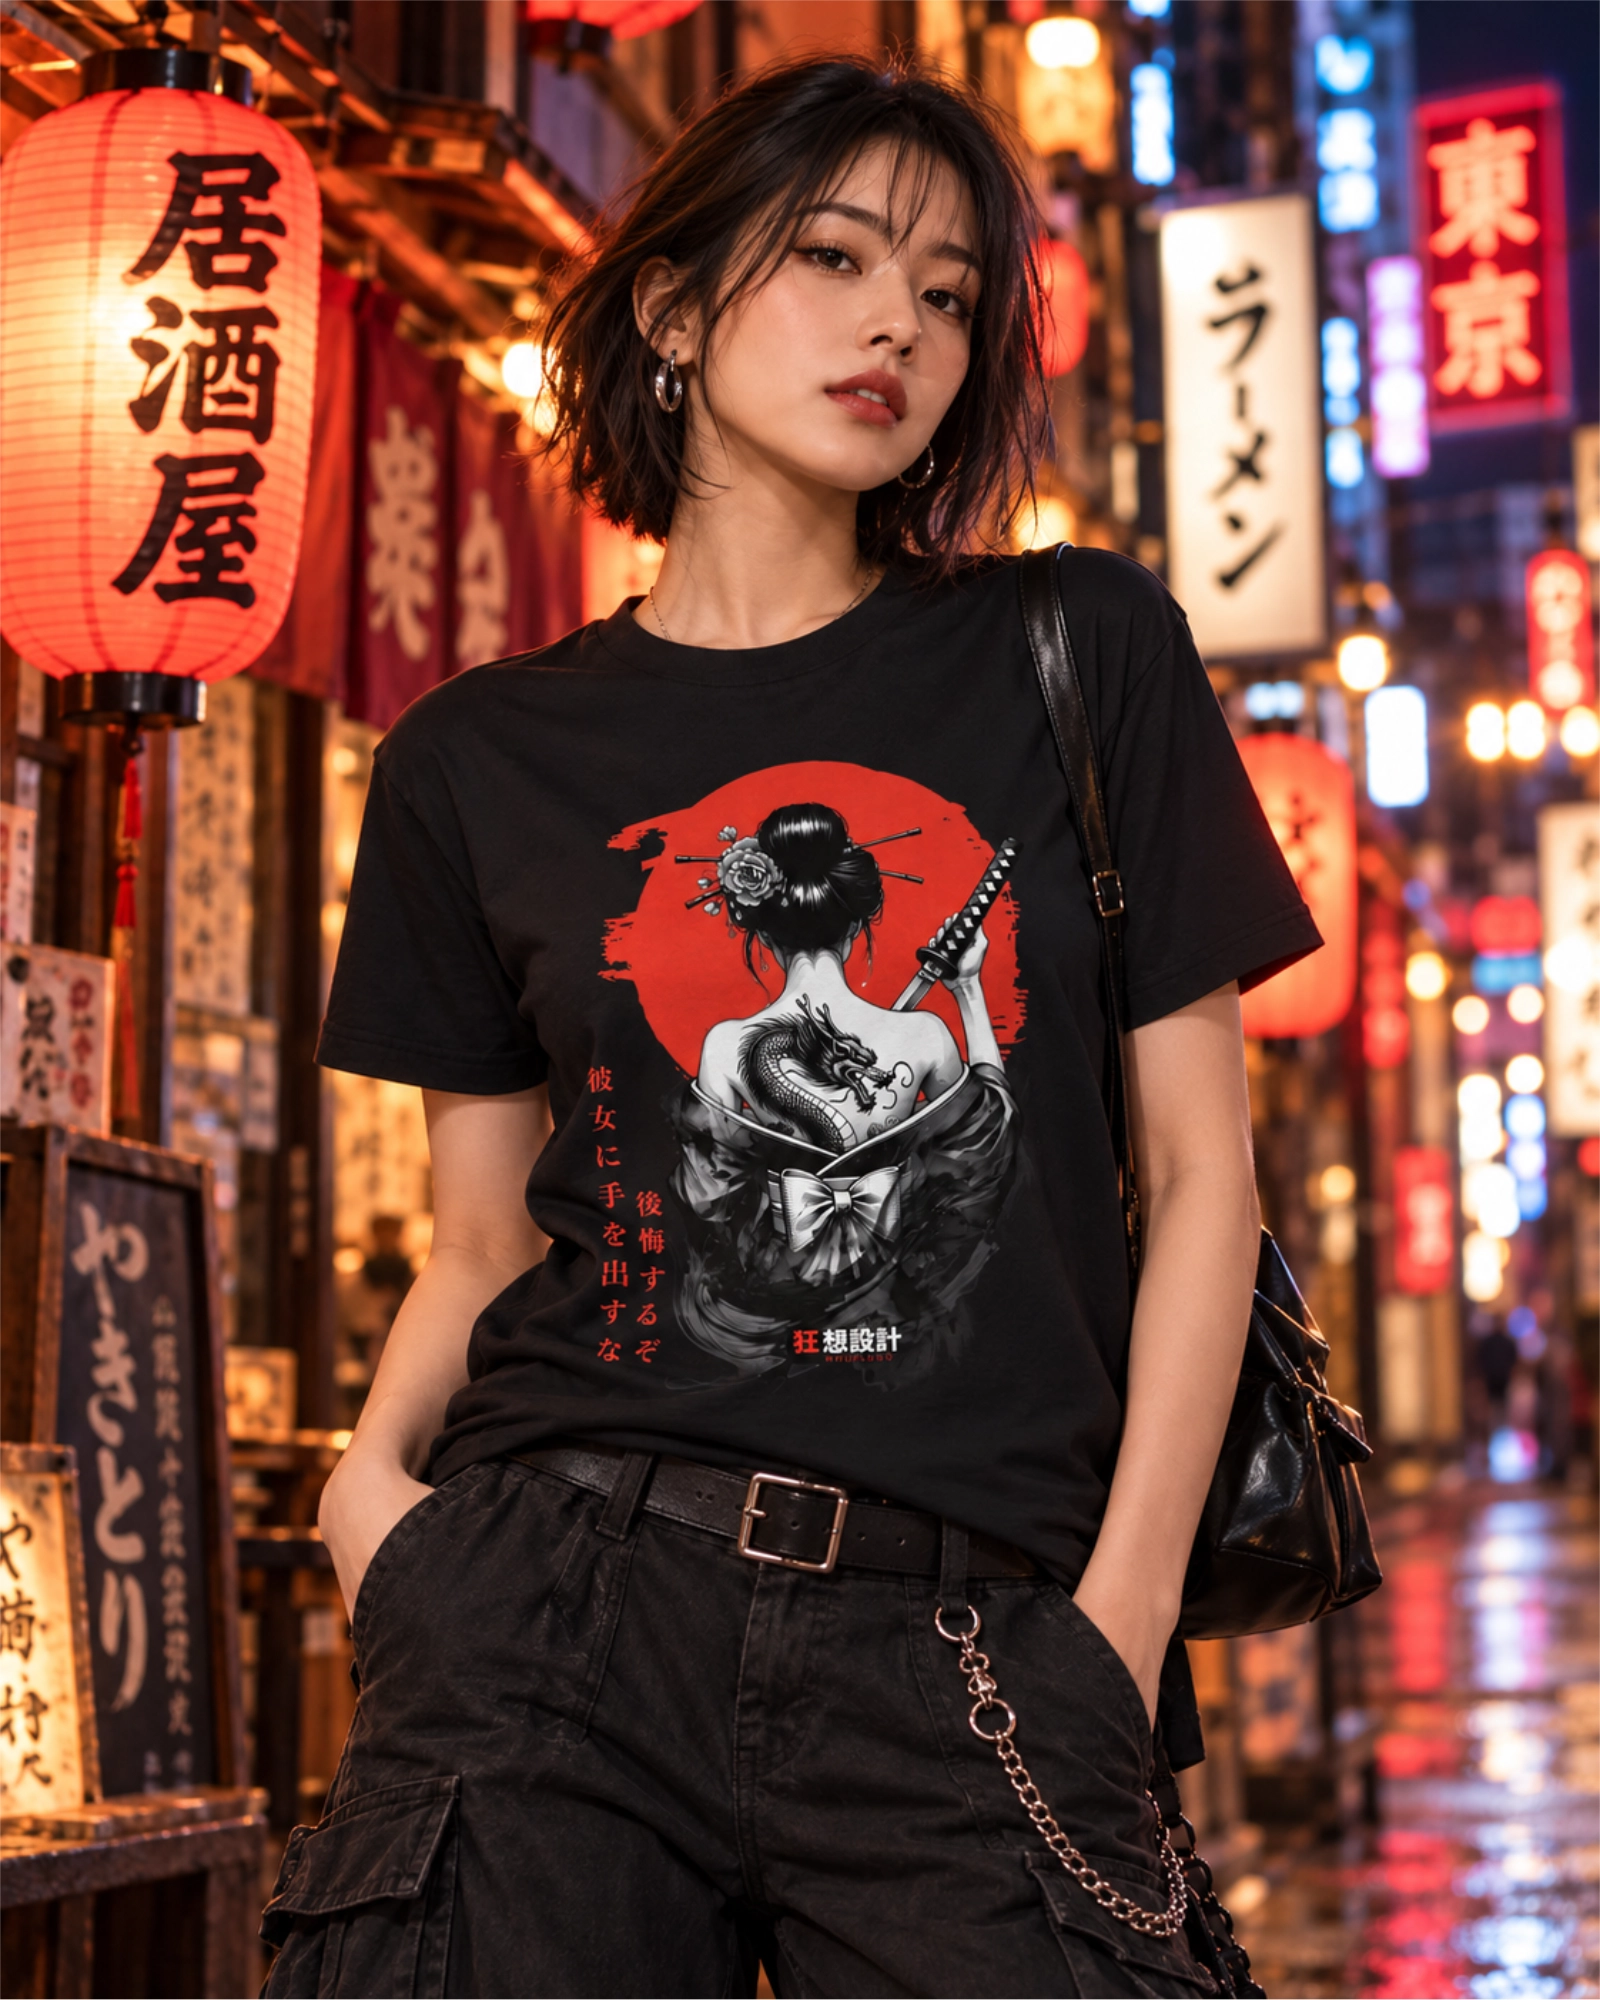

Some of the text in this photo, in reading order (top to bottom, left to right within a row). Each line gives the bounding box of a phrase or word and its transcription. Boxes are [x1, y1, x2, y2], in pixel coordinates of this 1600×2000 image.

[111, 150, 287, 609] 居酒屋
[1427, 117, 1542, 398] 東京
[1207, 256, 1286, 593] ラーメン
[586, 1065, 629, 1362] 彼女に手を出すな
[635, 1190, 666, 1363] 後悔するぞ
[72, 1203, 149, 1712] やきとり
